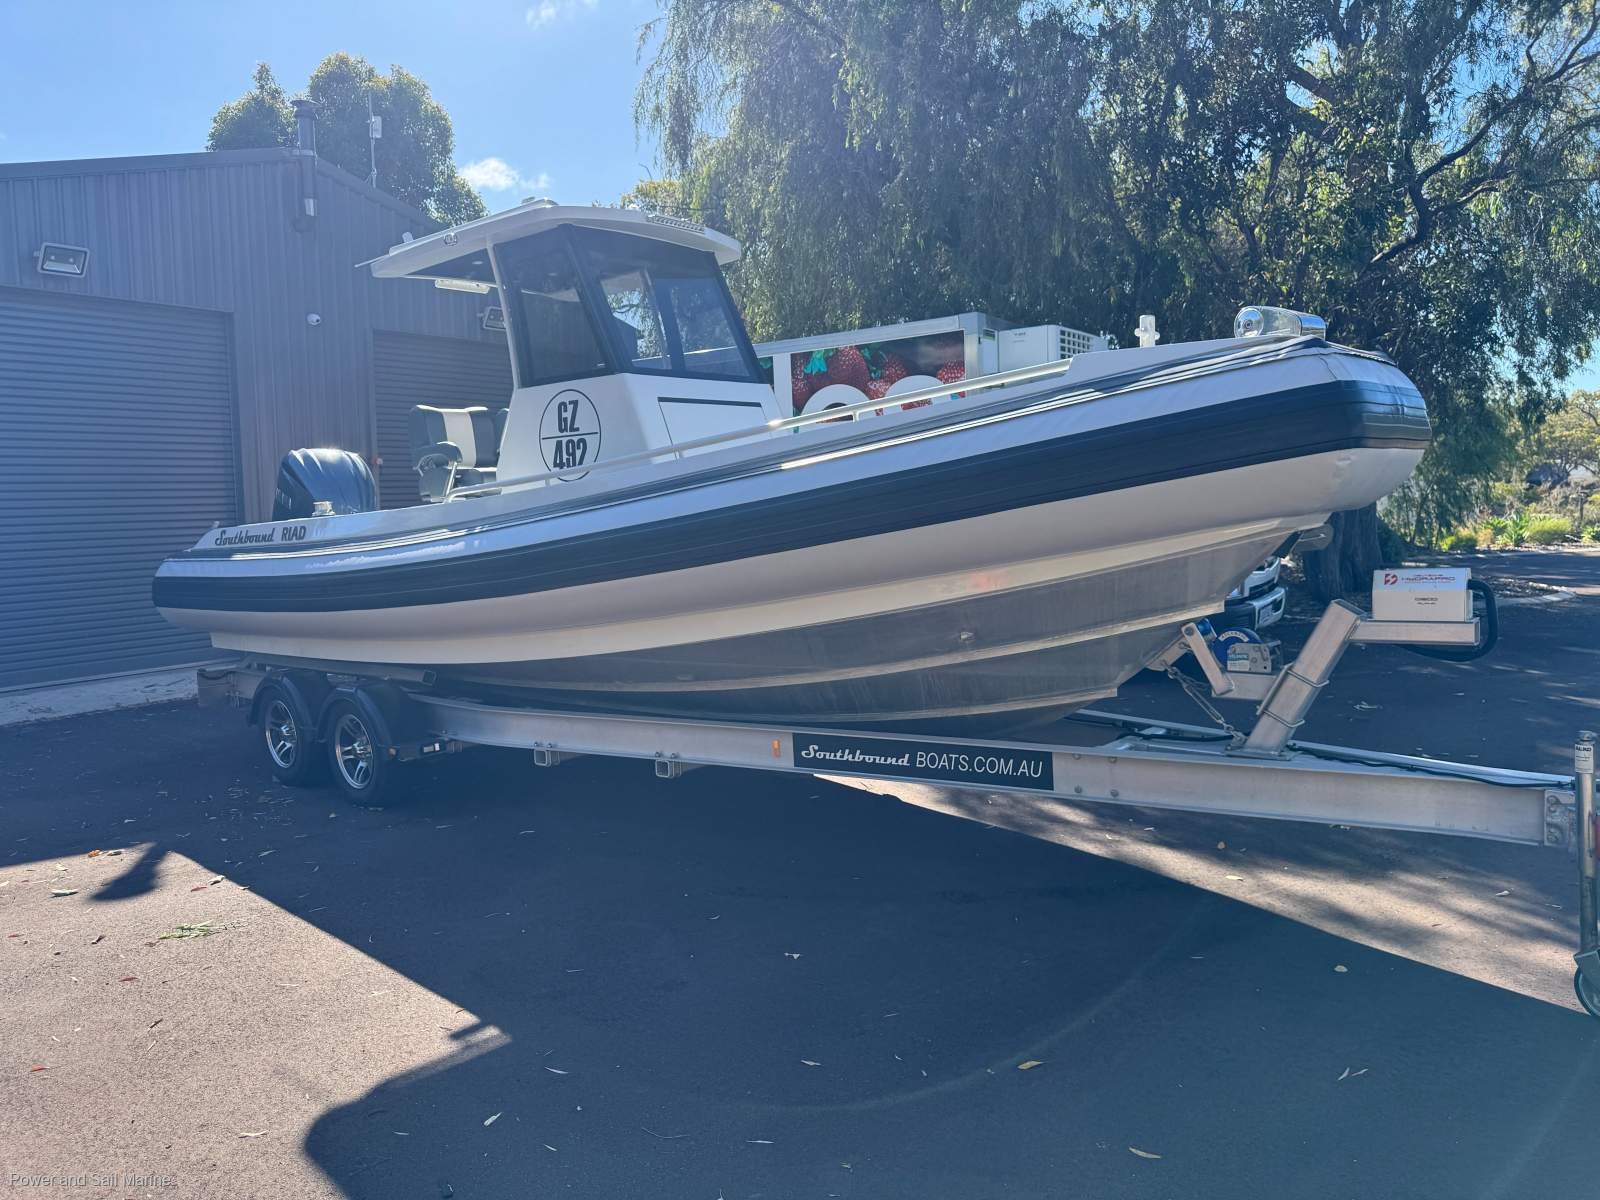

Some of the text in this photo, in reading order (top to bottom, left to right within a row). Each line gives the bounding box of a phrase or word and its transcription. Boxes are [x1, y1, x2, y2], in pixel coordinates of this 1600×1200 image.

[557, 399, 580, 434] GZ
[552, 437, 588, 470] 492
[214, 525, 307, 547] Southbound RIAD
[801, 744, 1044, 778] Southbound BOATS.COM.AU
